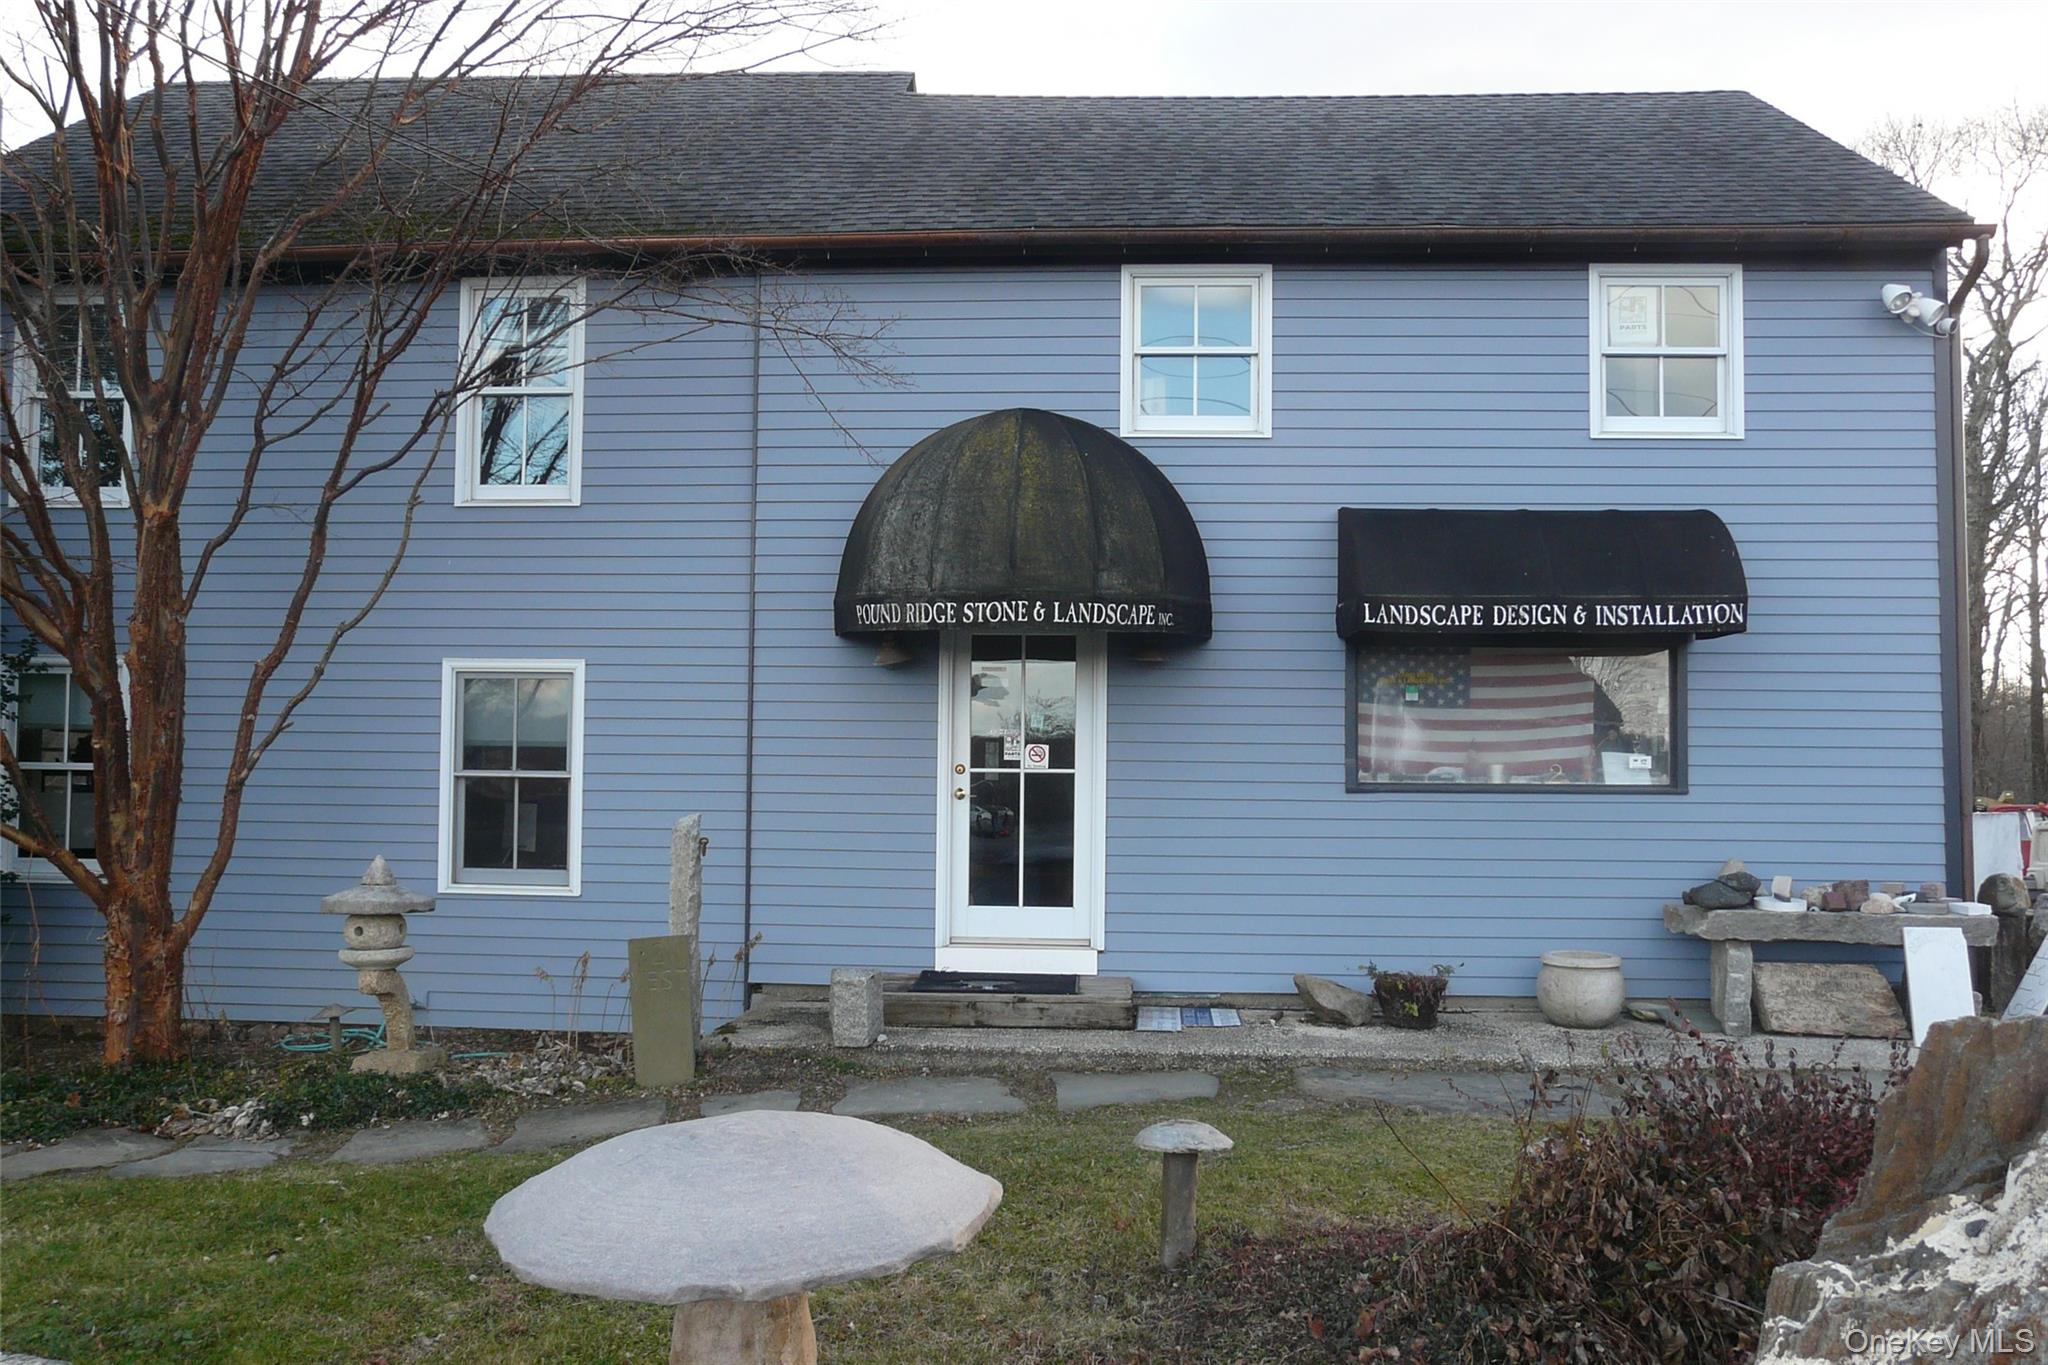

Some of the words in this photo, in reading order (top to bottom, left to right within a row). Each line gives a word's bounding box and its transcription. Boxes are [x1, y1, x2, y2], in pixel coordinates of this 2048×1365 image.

[855, 603, 901, 625] POUND
[905, 602, 957, 624] RIDGE
[962, 600, 1029, 624] STONE
[1033, 600, 1046, 622] &
[1053, 601, 1156, 626] LANDSCAPE
[1363, 602, 1484, 627] LANDSCAPE
[1492, 603, 1568, 627] DESIGN
[1573, 603, 1587, 626] &
[1595, 602, 1745, 627] INSTALLATION
